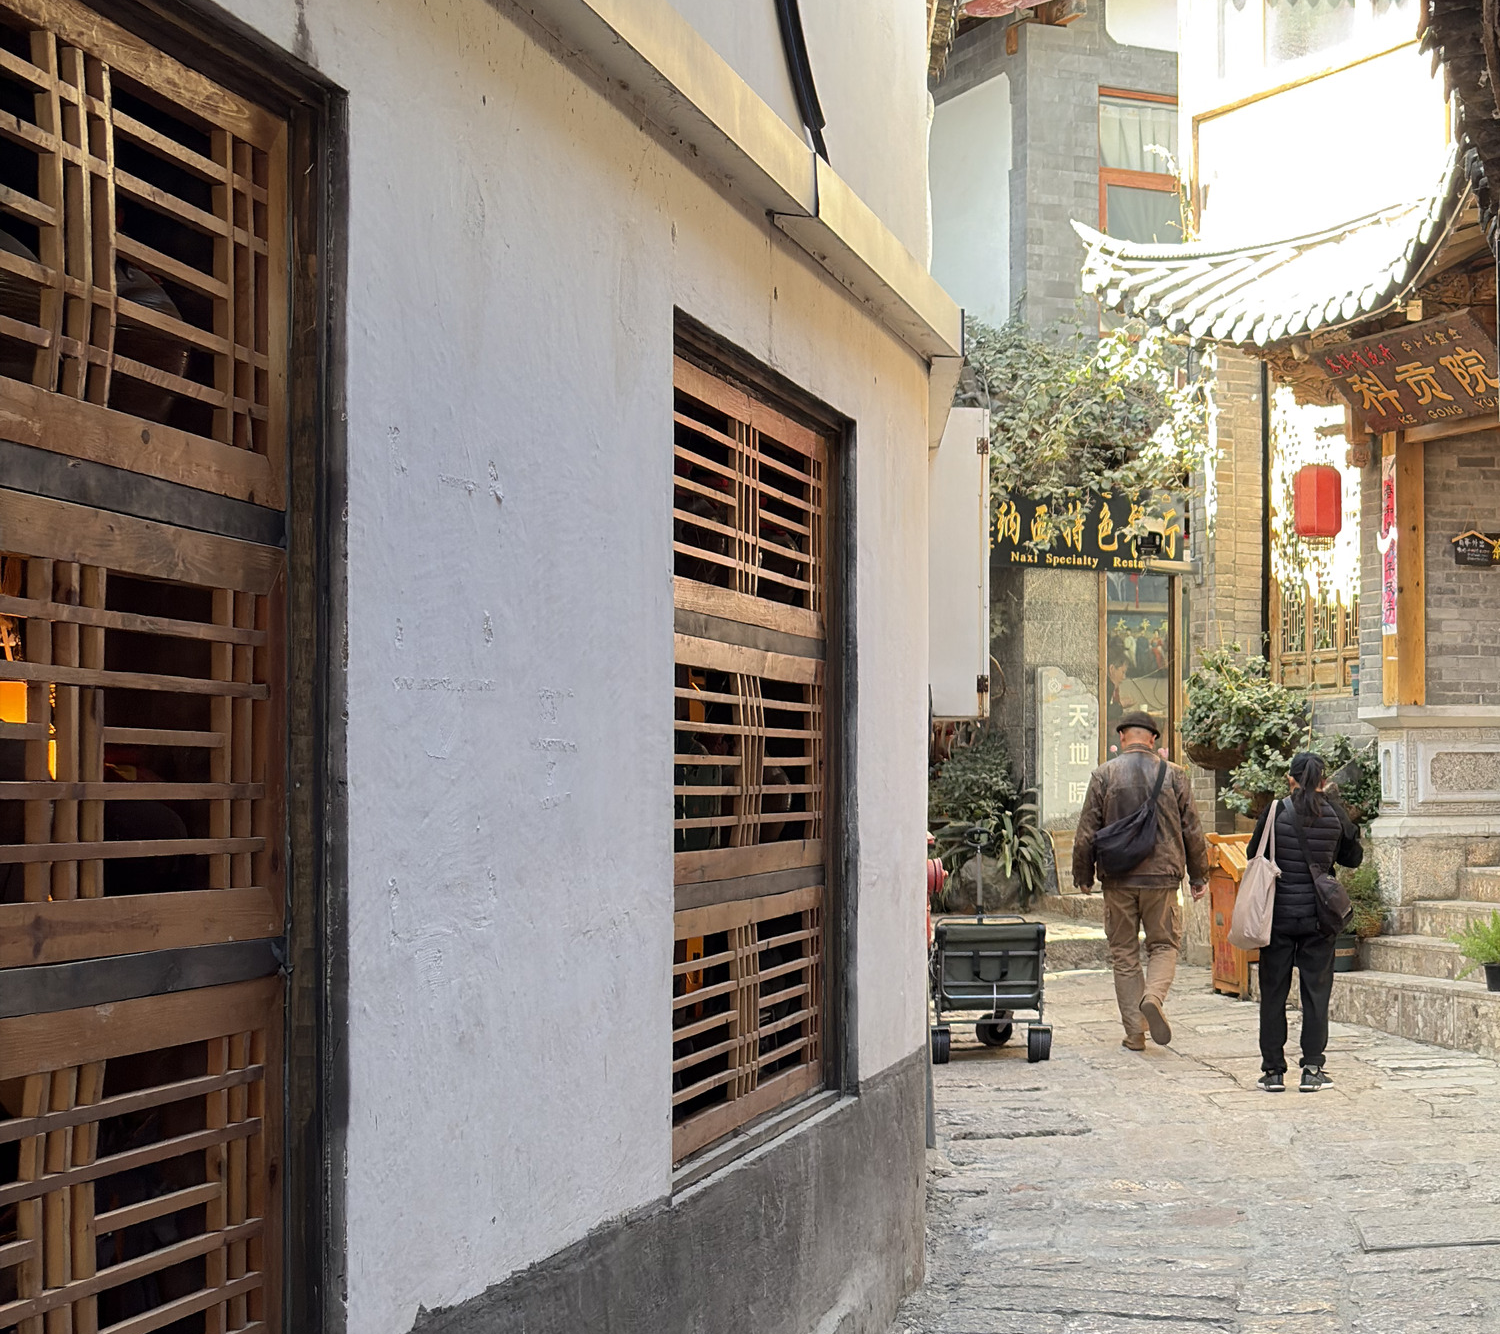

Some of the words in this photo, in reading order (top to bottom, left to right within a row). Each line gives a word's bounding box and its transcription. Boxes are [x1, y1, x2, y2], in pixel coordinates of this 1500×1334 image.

[1346, 346, 1500, 417] 科贡院
[1398, 413, 1418, 425] KE
[1428, 405, 1464, 419] GONG
[1010, 551, 1038, 564] Naxi
[1046, 553, 1099, 569] Specialty
[1068, 704, 1090, 804] 天地院
